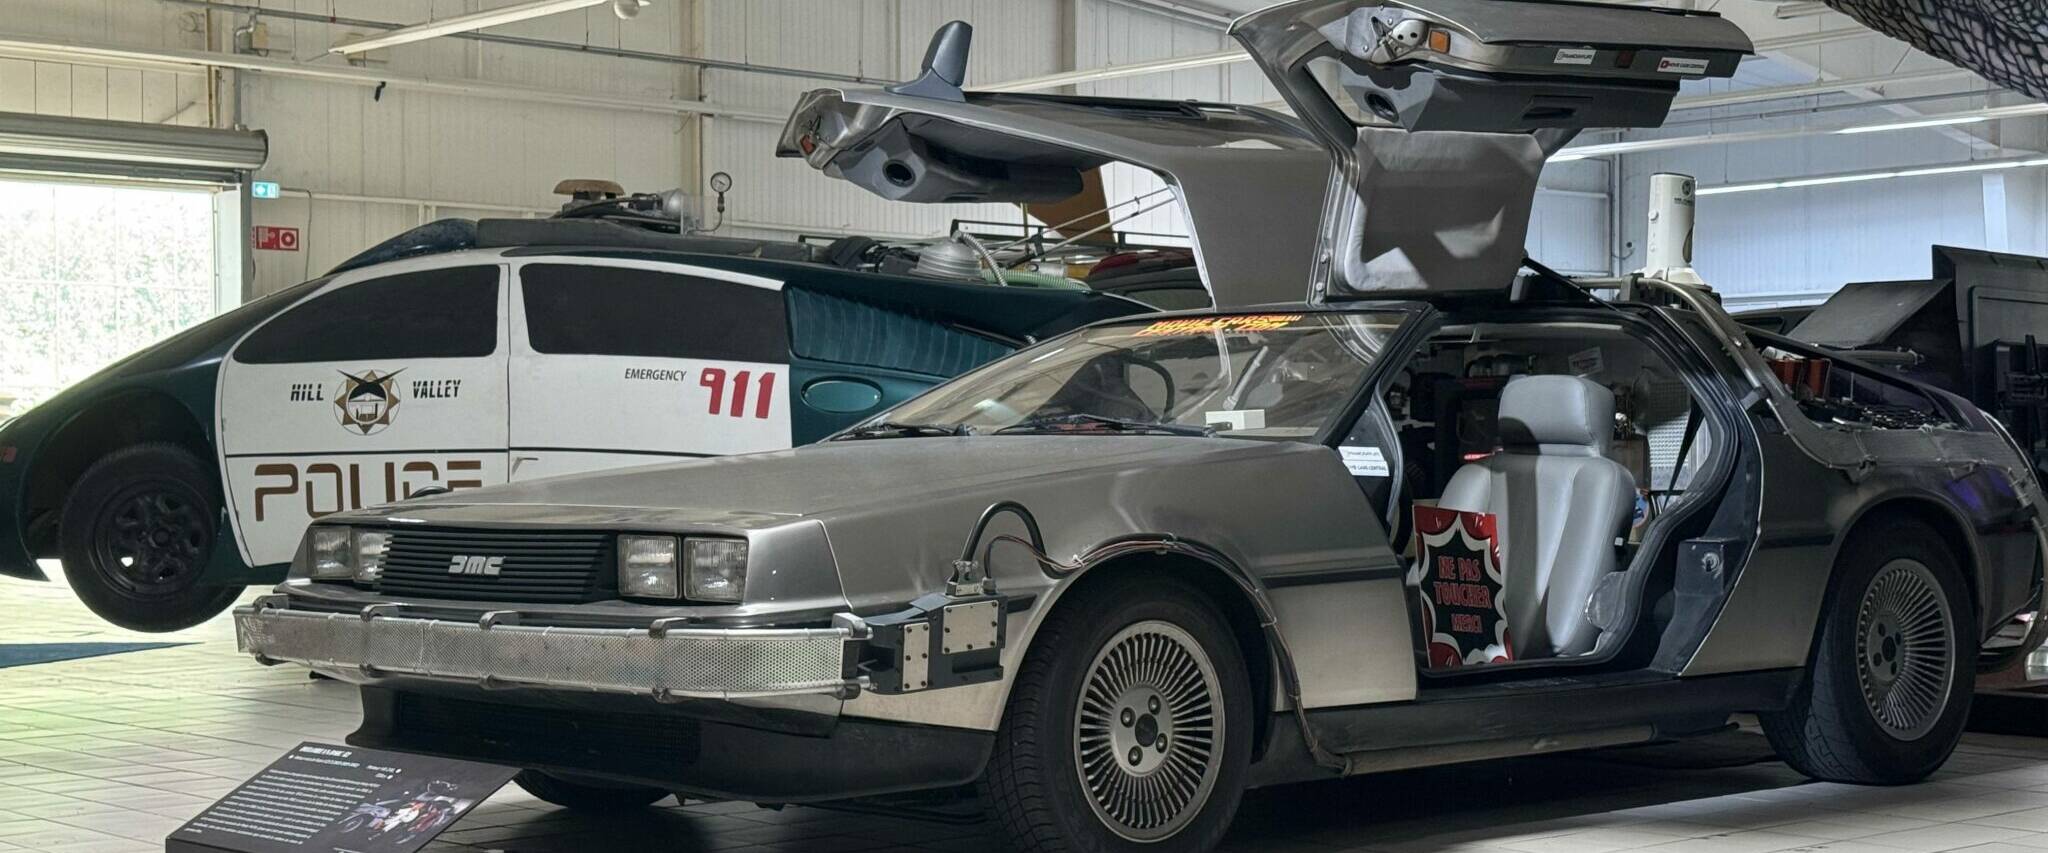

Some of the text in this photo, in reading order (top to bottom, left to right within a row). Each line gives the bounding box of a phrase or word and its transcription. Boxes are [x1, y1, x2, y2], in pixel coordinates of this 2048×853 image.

[290, 379, 461, 402] HILL VALLEY
[625, 367, 776, 419] EMERGENCY 911
[448, 554, 506, 576] DMC
[1437, 555, 1482, 582] NE PAS
[1433, 581, 1492, 608] TOUCHER
[1451, 613, 1483, 633] MERCI
